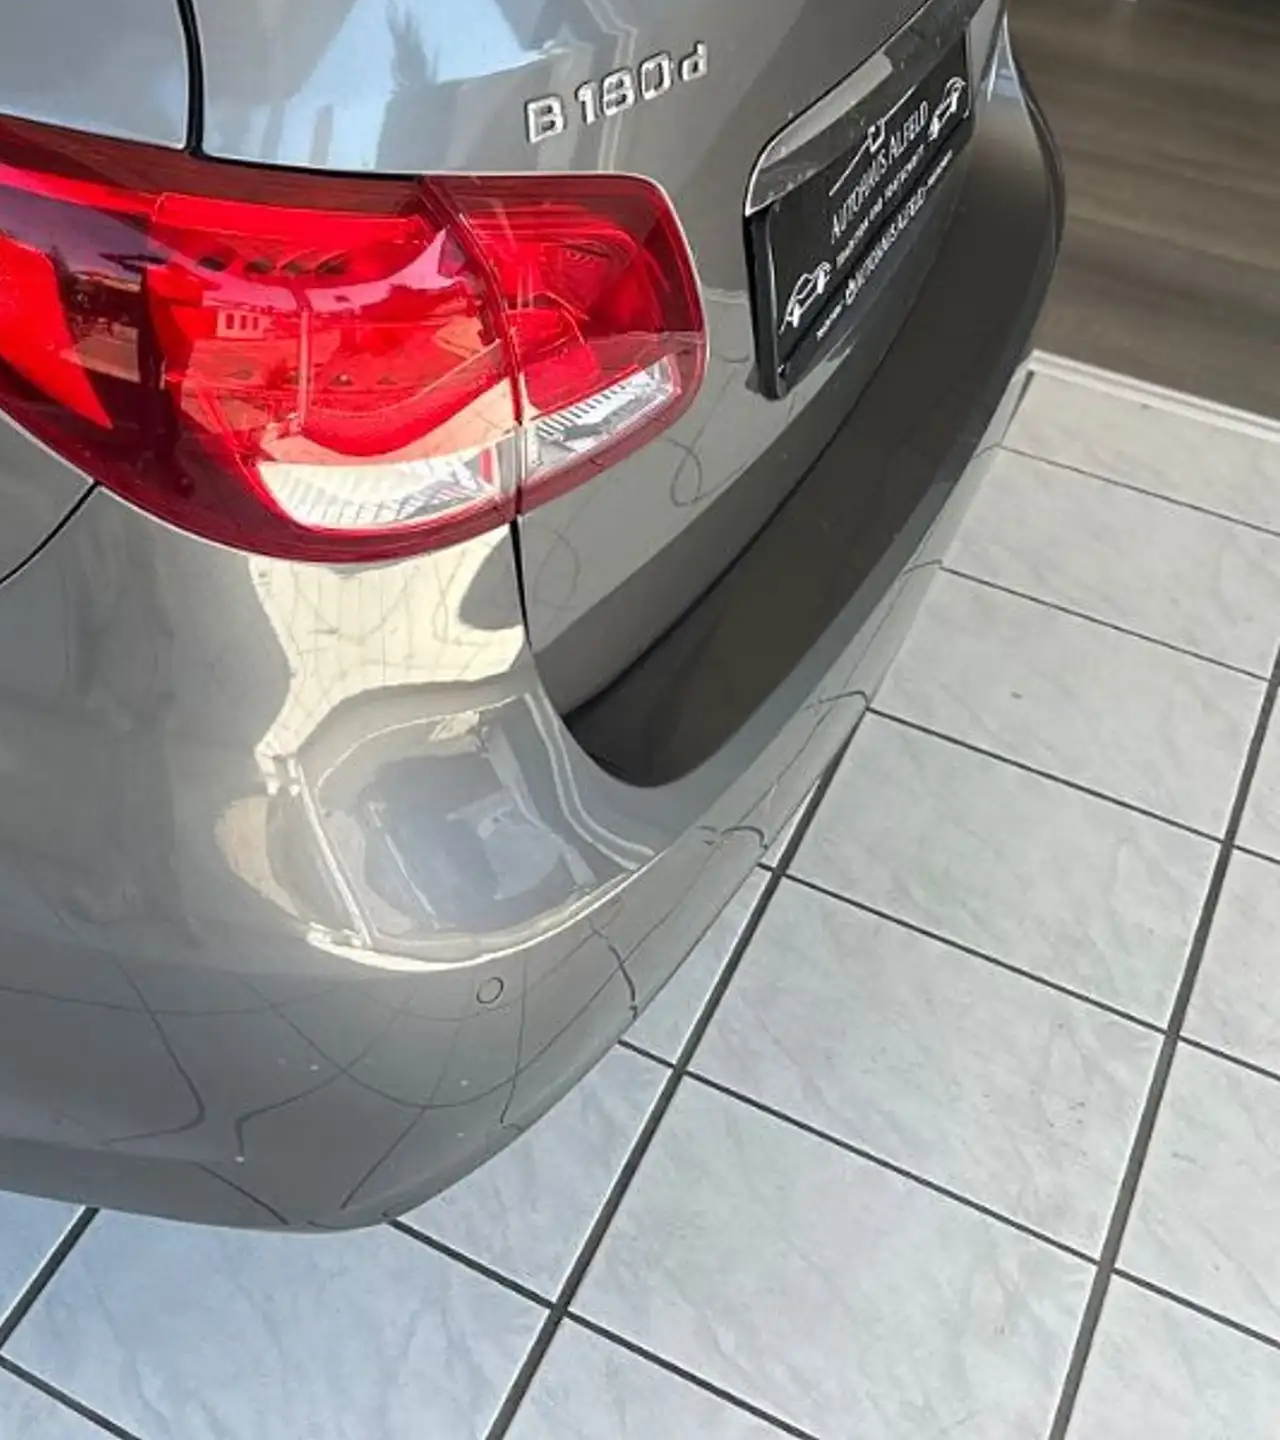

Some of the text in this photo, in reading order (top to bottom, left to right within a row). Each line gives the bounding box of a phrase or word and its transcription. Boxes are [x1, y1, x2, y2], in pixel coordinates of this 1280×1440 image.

[526, 94, 565, 144] B
[831, 148, 888, 245] AUTOHAUS
[889, 101, 929, 165] ALFELD
